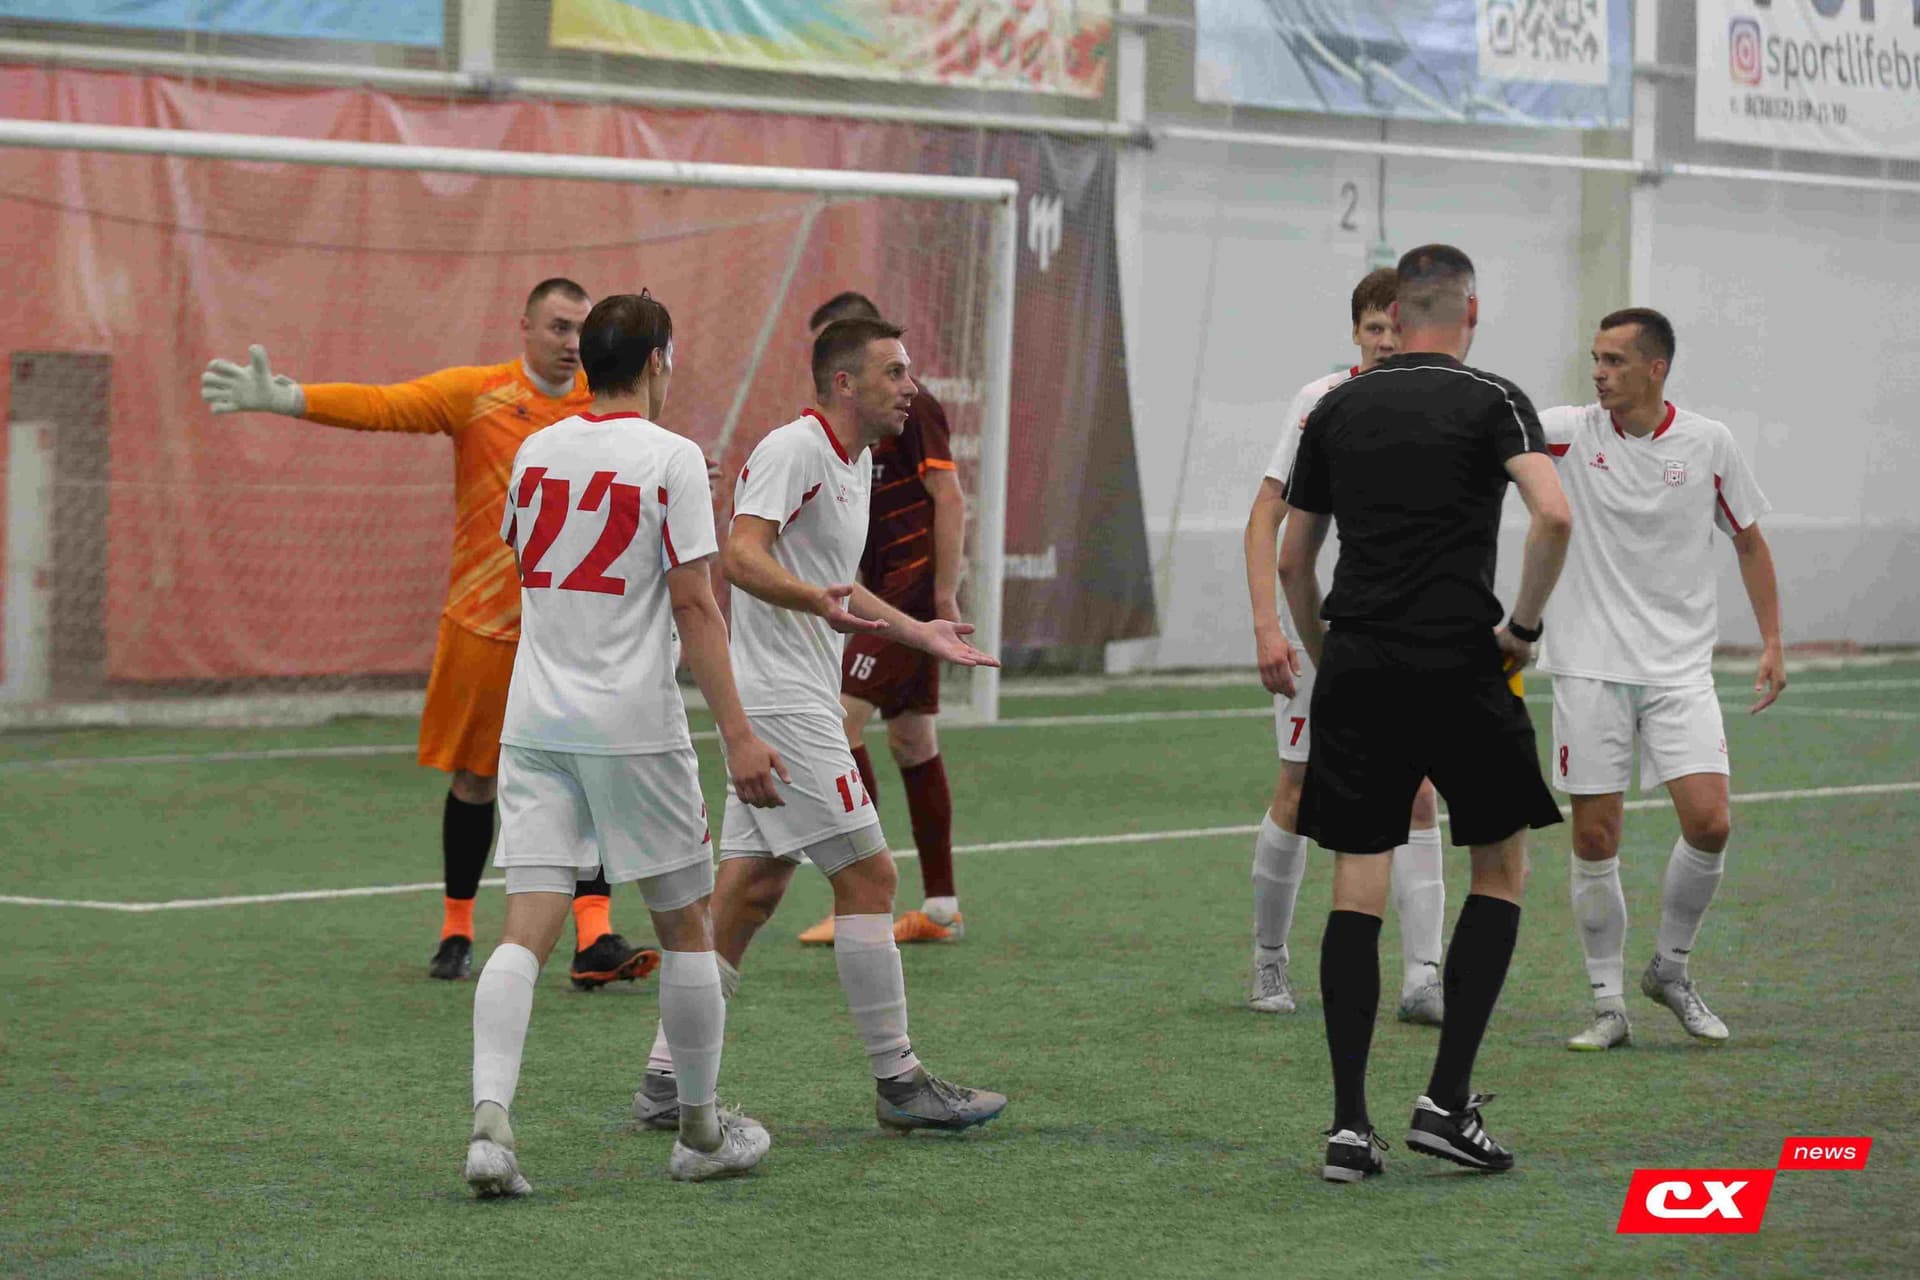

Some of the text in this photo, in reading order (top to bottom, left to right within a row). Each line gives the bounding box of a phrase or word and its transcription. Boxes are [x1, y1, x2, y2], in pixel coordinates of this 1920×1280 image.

[1766, 31, 1920, 90] sportlifeb
[1341, 181, 1359, 231] 2
[517, 467, 640, 596] 22
[1290, 716, 1306, 746] 7
[1559, 744, 1569, 777] 8
